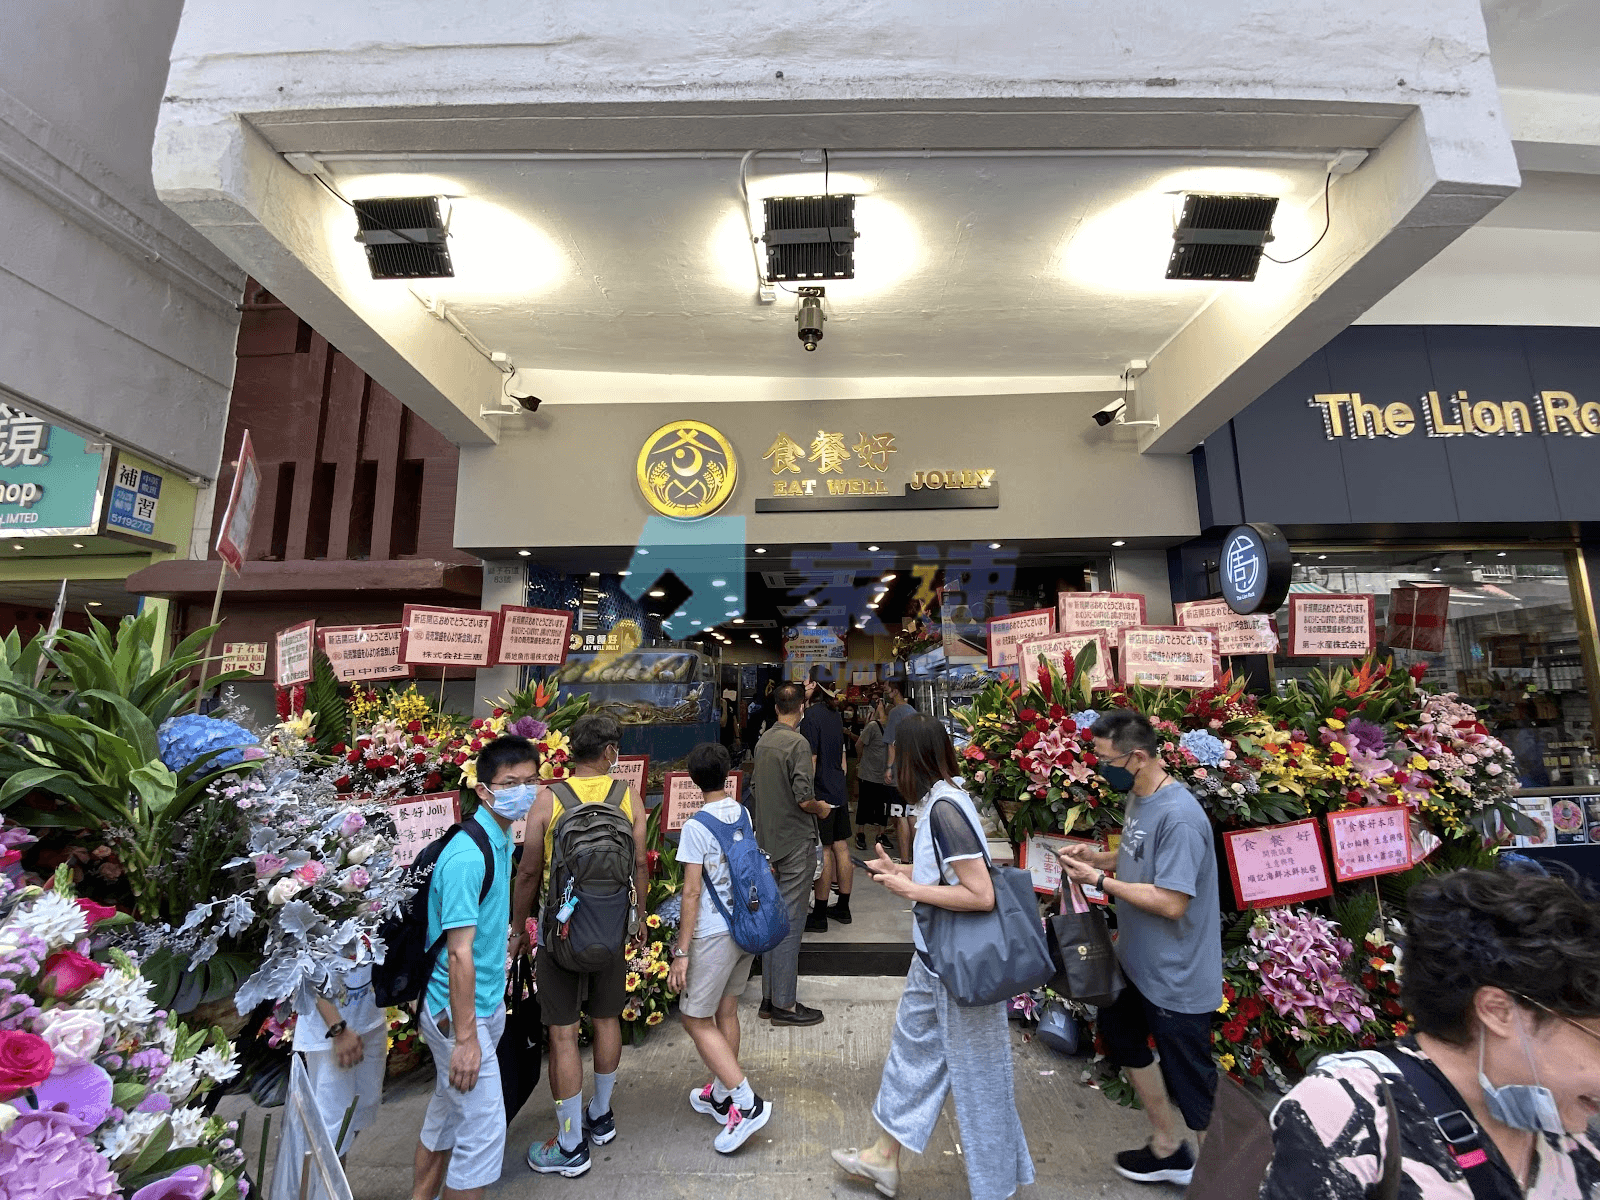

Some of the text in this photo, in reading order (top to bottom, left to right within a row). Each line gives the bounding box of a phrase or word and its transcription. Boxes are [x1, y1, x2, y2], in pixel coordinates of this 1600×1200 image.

[1311, 393, 1416, 438] The
[1423, 390, 1532, 437] Lion
[120, 464, 138, 488] 補
[773, 469, 996, 496] EAT WELL JOLLY
[138, 497, 155, 519] 習
[111, 513, 152, 532] 51192712
[426, 804, 448, 817] Jolly
